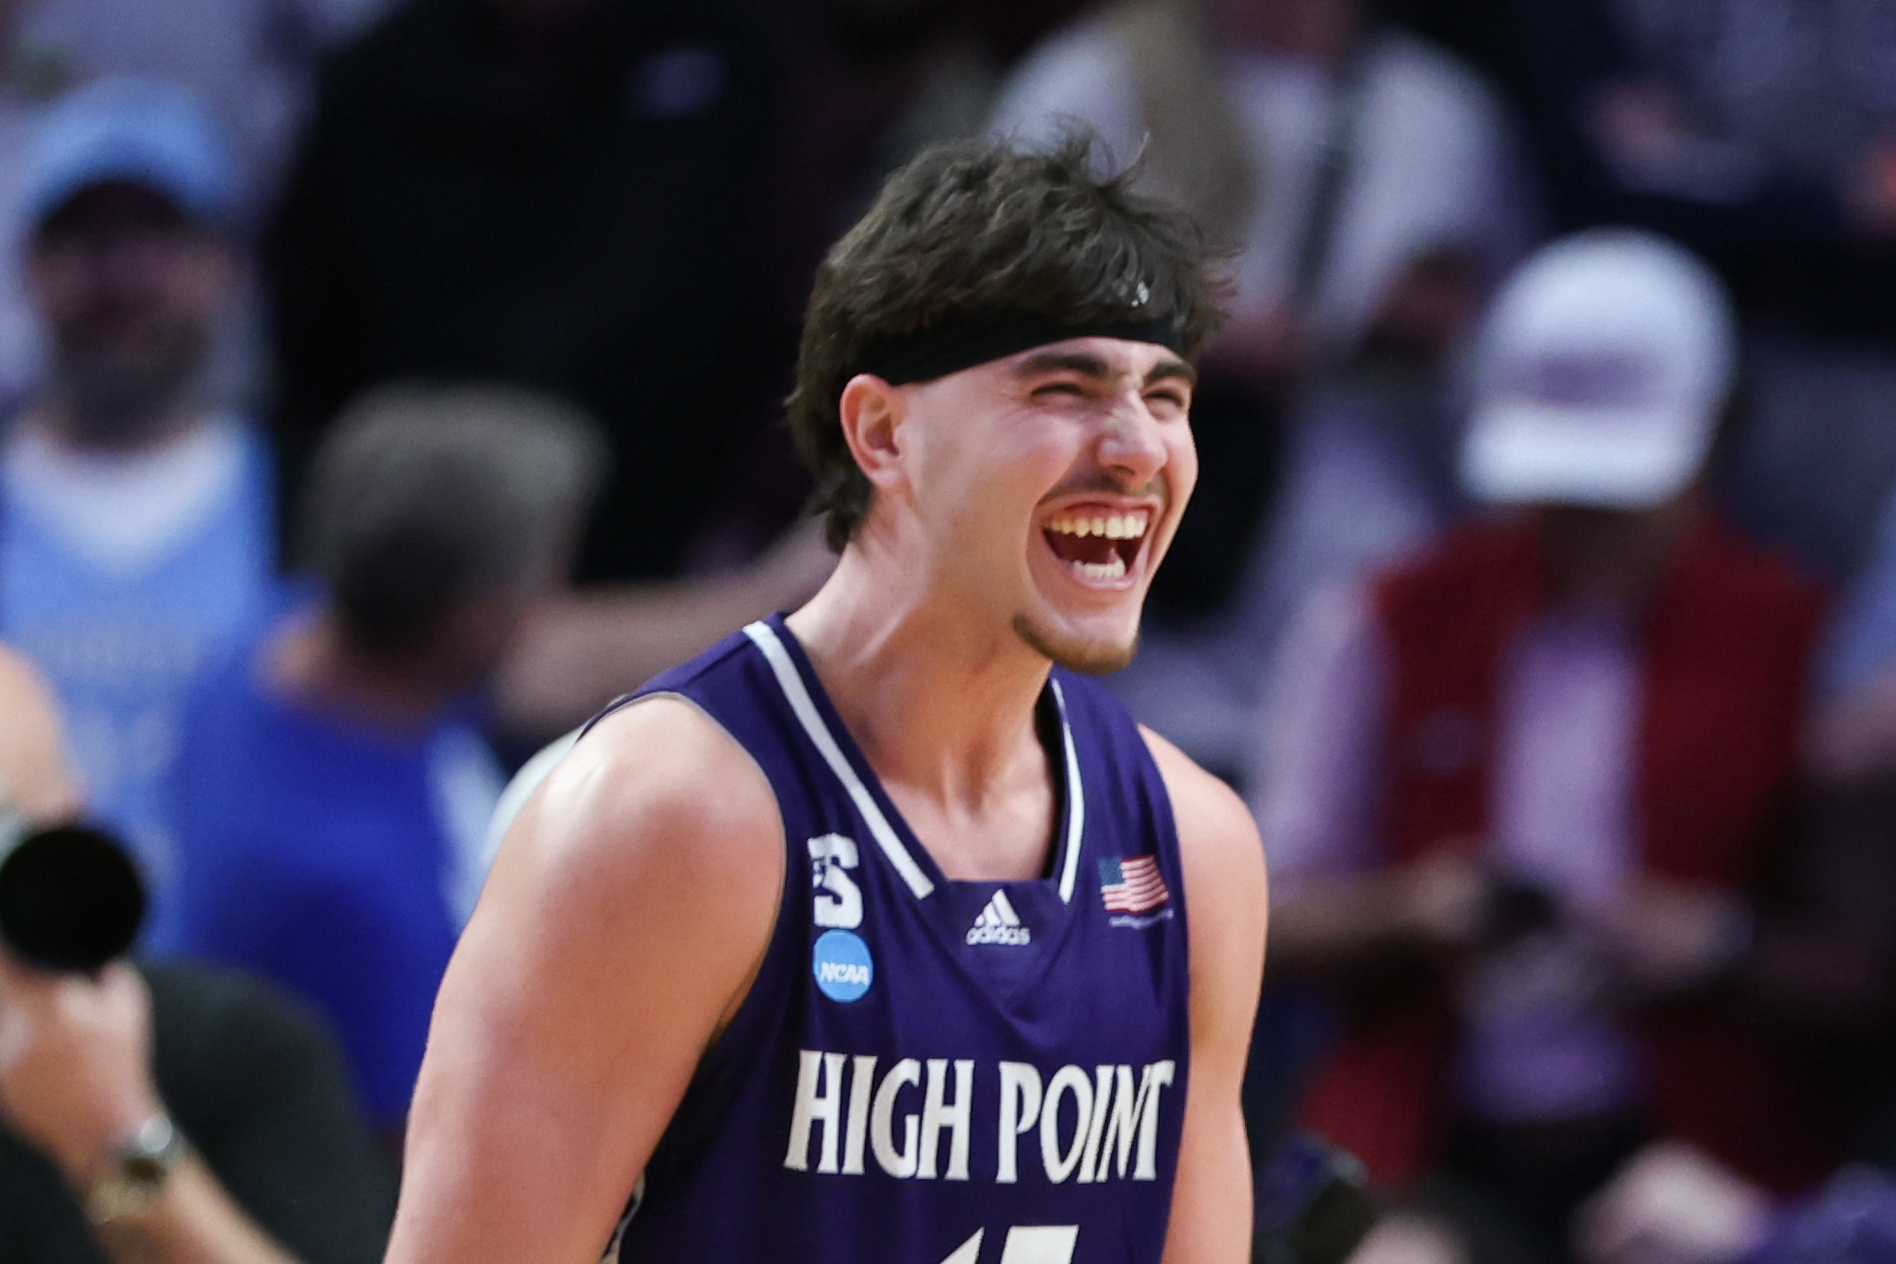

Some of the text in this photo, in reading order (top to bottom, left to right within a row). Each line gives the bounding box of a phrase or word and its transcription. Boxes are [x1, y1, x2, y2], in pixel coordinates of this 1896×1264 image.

[820, 961, 872, 987] NCAA
[783, 1049, 1176, 1184] HIGH POINT
